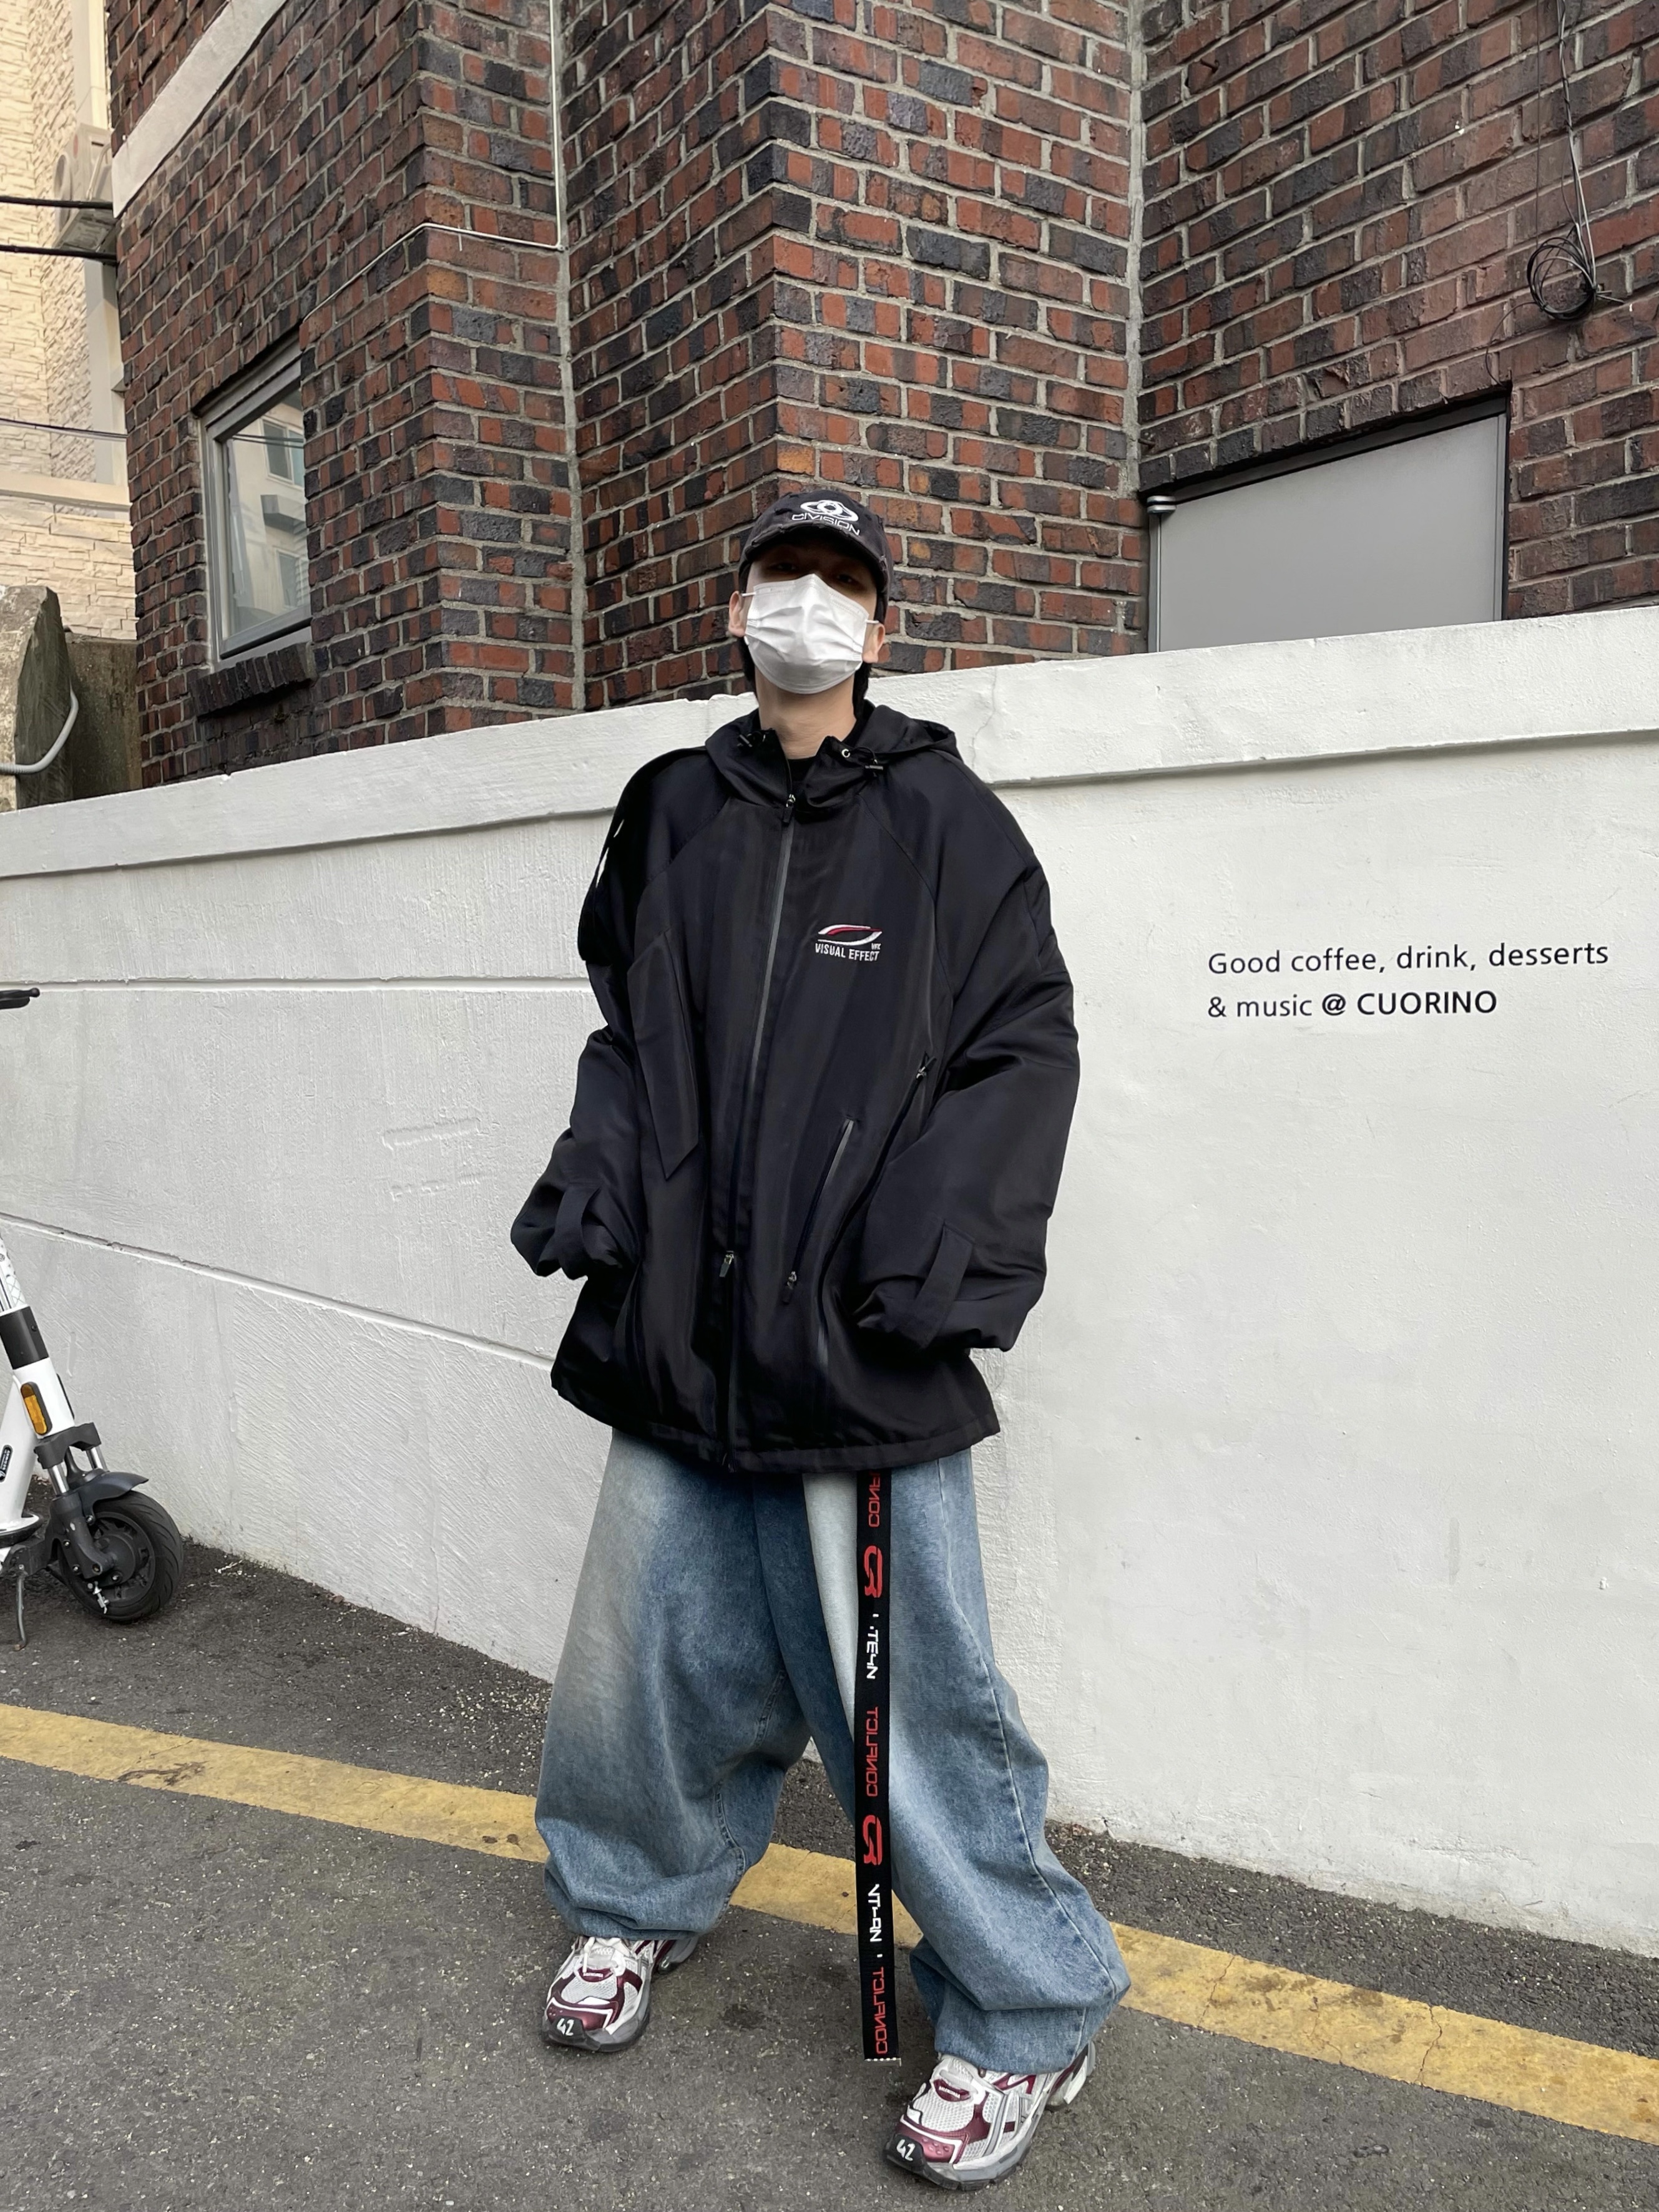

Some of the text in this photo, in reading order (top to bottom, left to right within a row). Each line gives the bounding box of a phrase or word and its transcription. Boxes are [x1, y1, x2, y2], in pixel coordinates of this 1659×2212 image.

[815, 943, 879, 962] VISUAL EFFECT
[1208, 942, 1609, 975] Good coffee, drink, desserts
[1208, 990, 1497, 1018] & music @ CUORINO
[556, 2017, 575, 2037] 42
[896, 2138, 916, 2161] 42
